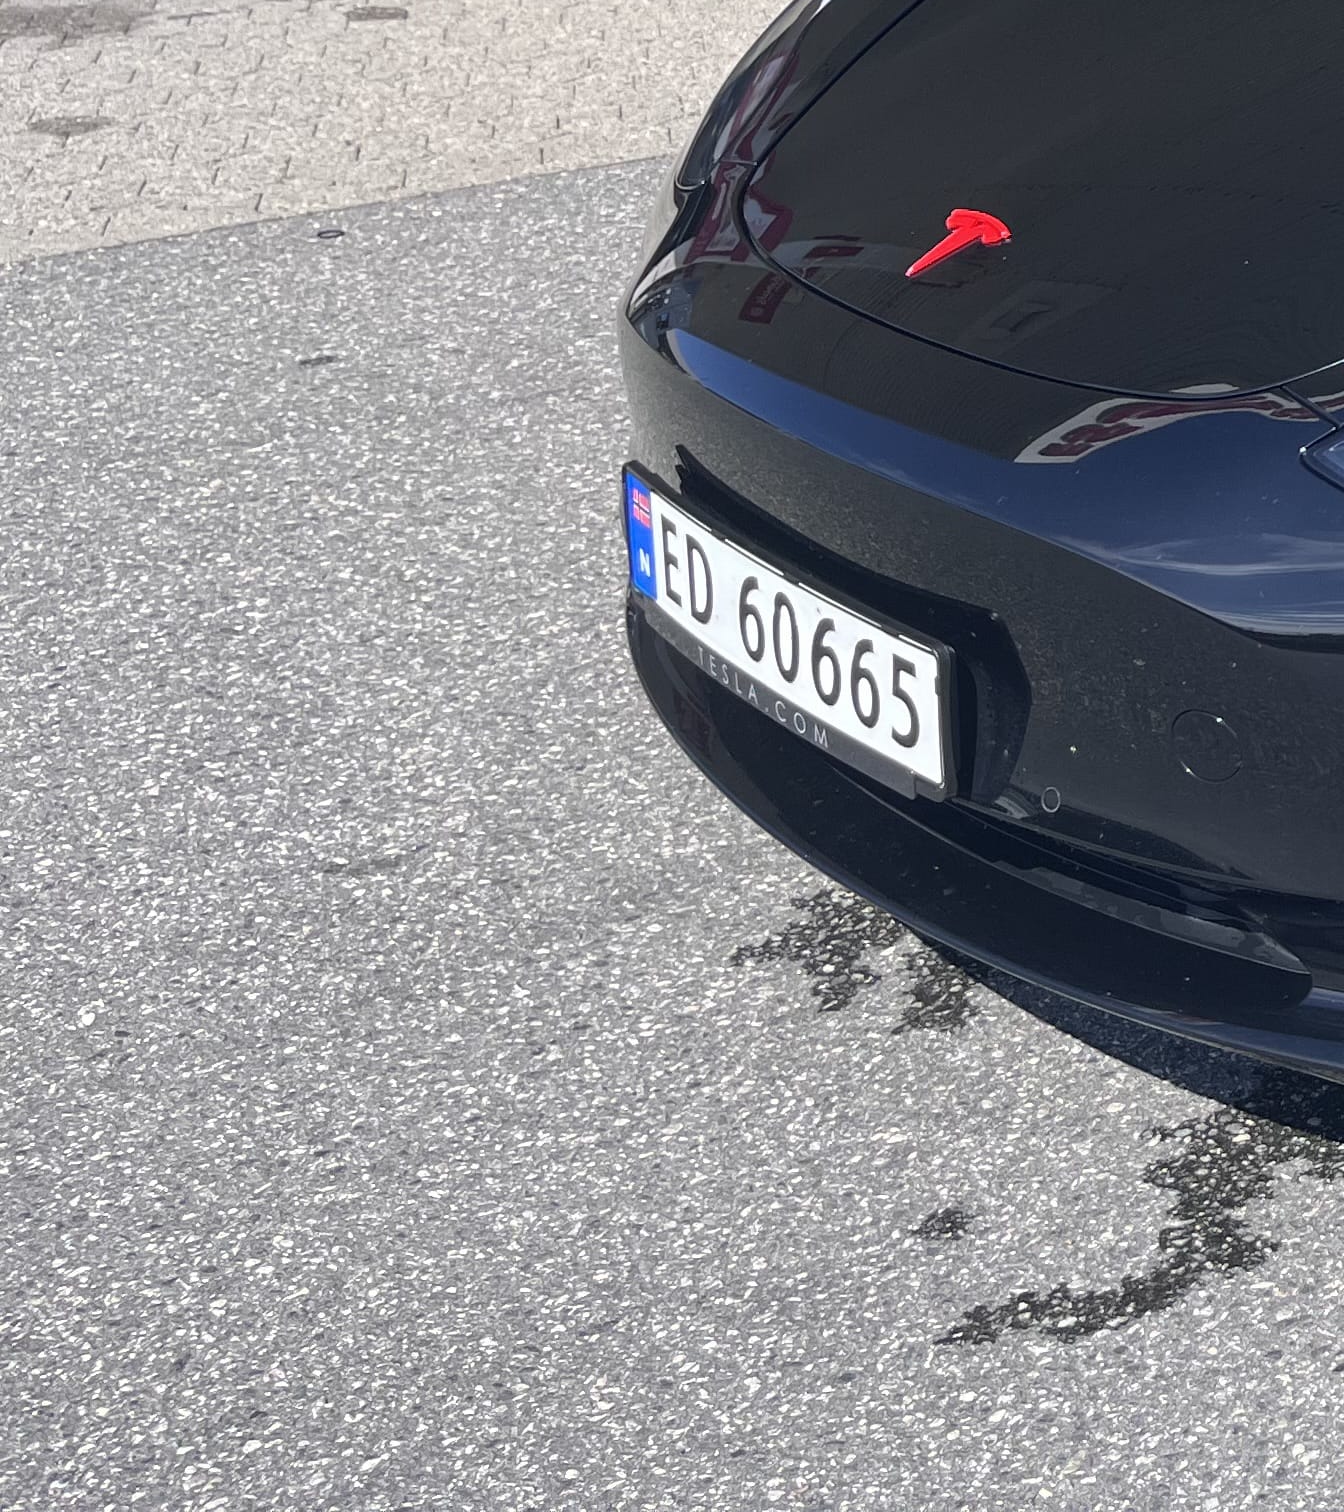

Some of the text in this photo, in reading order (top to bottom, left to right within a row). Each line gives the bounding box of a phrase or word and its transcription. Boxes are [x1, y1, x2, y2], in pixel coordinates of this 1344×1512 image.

[639, 548, 651, 577] N
[660, 512, 922, 749] ED 60665
[697, 645, 830, 749] TESLA.COM
